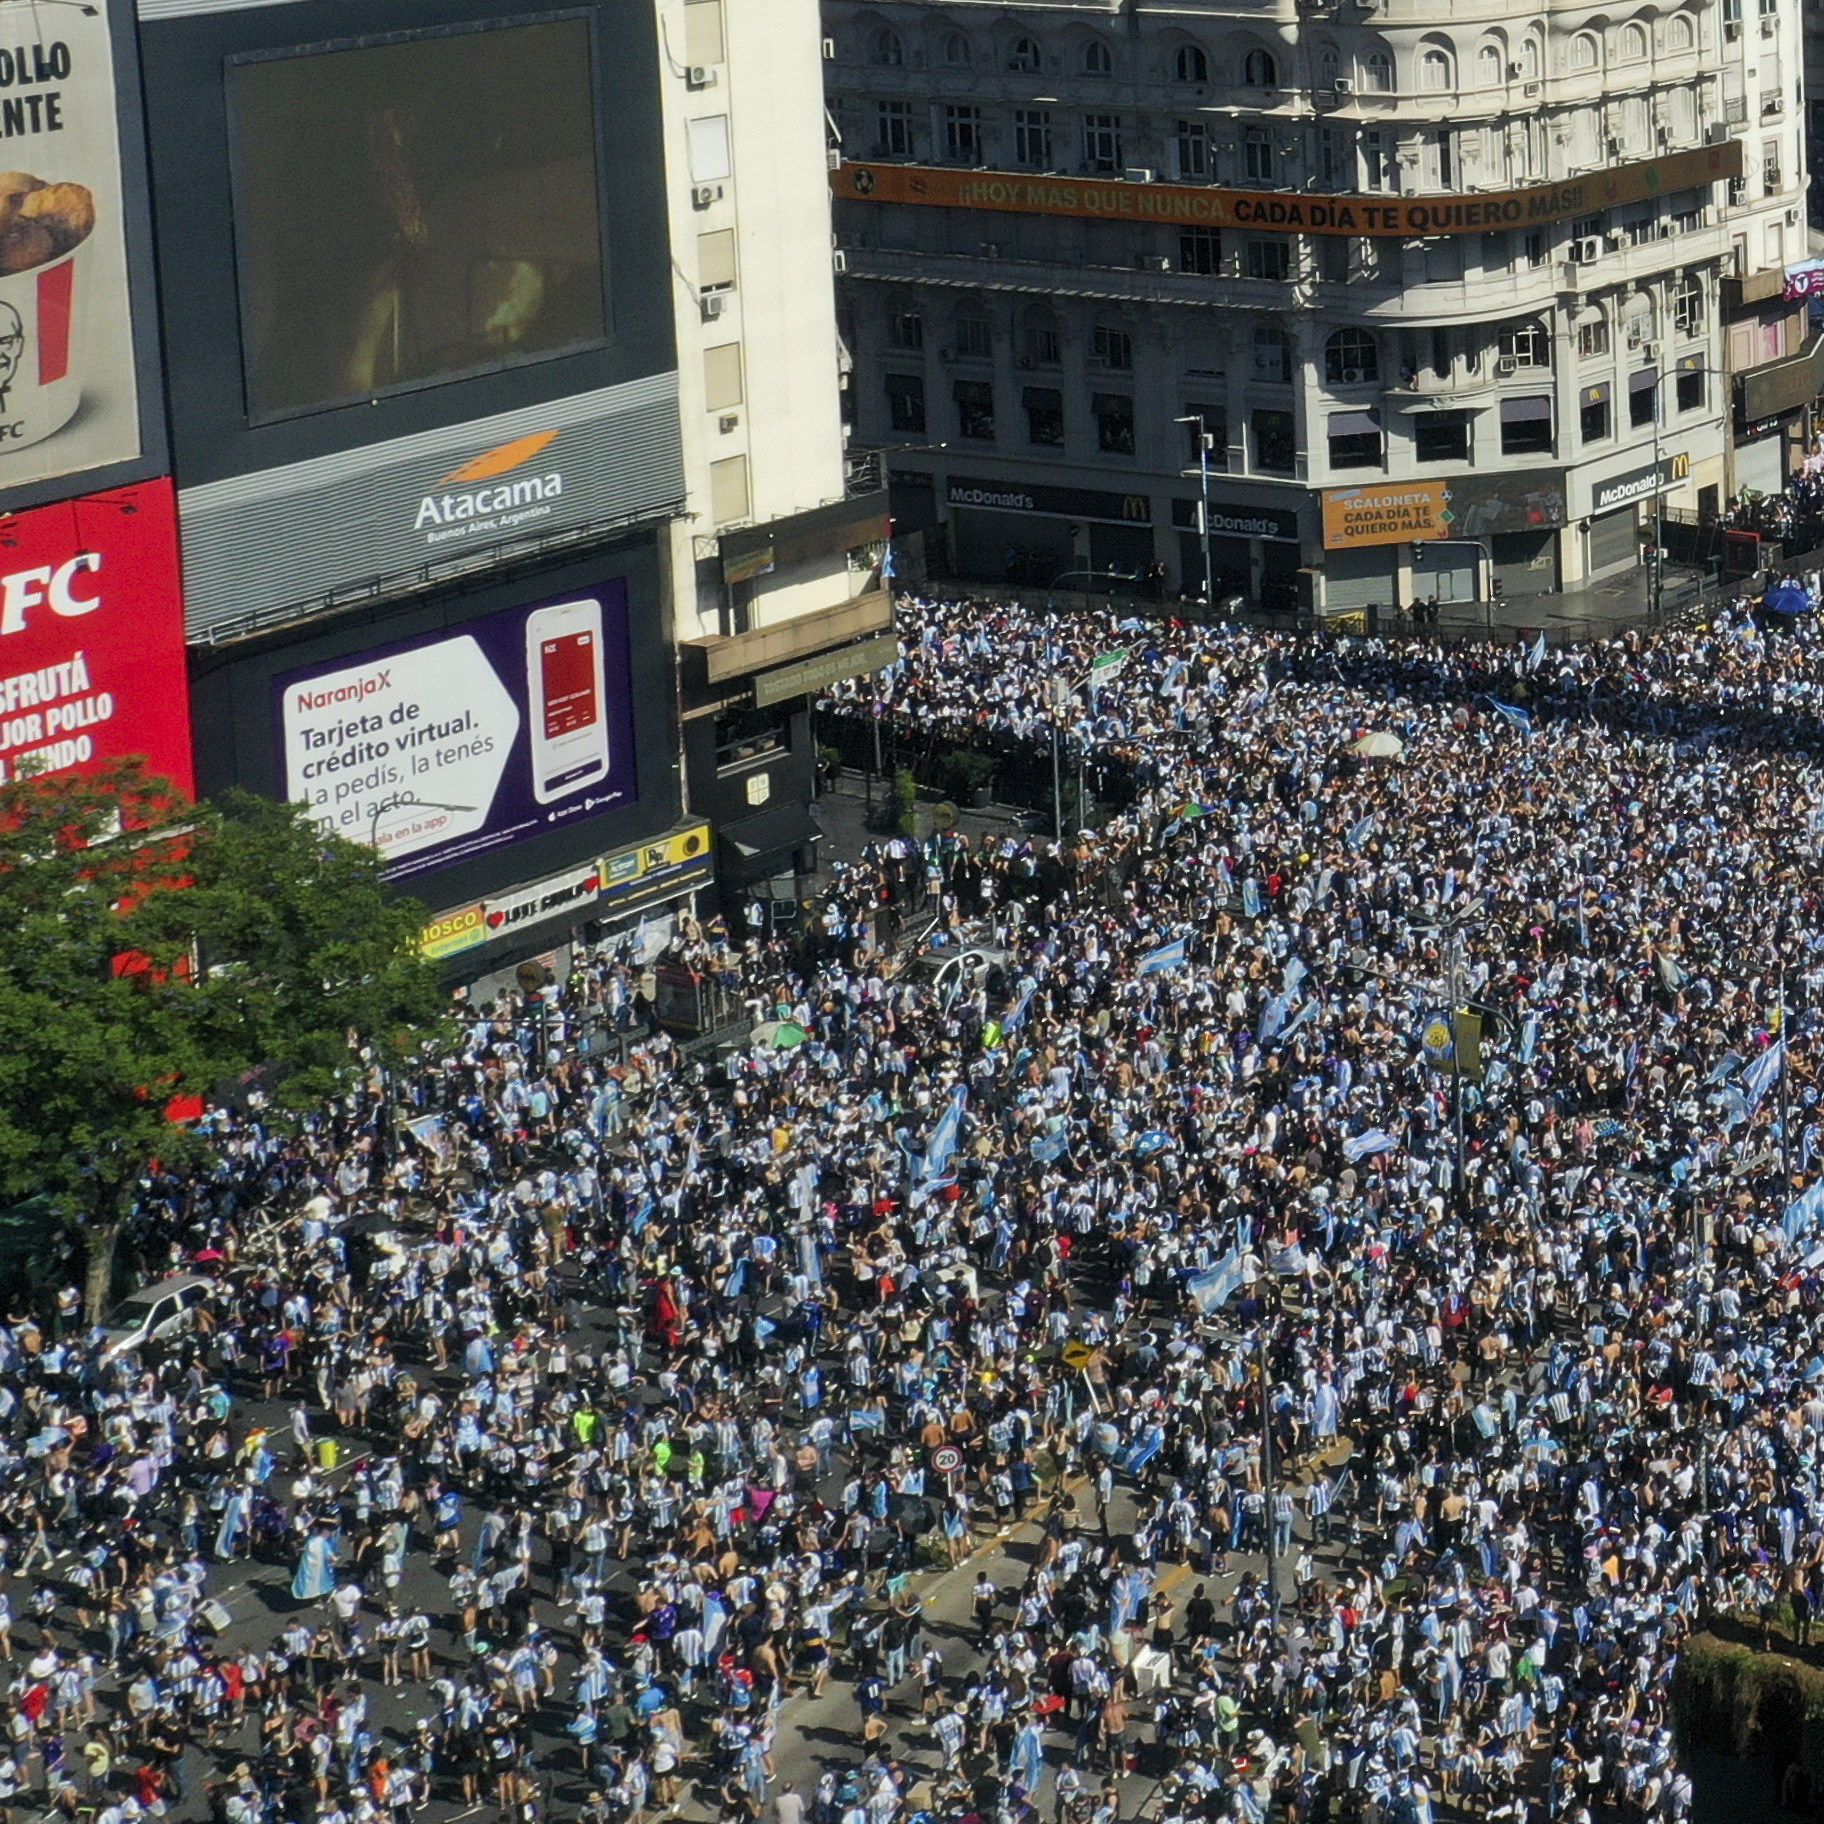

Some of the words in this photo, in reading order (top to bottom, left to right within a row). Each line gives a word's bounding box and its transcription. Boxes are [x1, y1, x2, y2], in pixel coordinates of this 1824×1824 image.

[0, 91, 64, 139] NTE
[1083, 190, 1132, 215] QUE
[1136, 192, 1232, 222] NUNCA,
[1233, 199, 1304, 225] CADA
[1309, 198, 1353, 229] DÍA
[1361, 206, 1401, 229] TE
[1407, 197, 1523, 232] QUIERO
[413, 472, 562, 530] Atacama
[950, 486, 1035, 509] McDonald's
[1343, 492, 1432, 511] SCALONETA
[1343, 510, 1384, 524] CADA
[1385, 507, 1411, 521] DÍA
[1413, 505, 1431, 518] TE
[427, 526, 466, 544] Buenos
[499, 504, 551, 526] Argentina
[1343, 520, 1398, 538] QUIERO
[0, 552, 101, 636] FC
[46, 691, 114, 737] POLLO
[300, 713, 384, 752] Tarjeta
[389, 701, 420, 725] de
[301, 740, 390, 780] crédito
[395, 708, 480, 752] virtual.
[335, 763, 406, 805] pedís,
[411, 755, 430, 776] la
[435, 734, 495, 768] tenés
[340, 801, 361, 827] el
[365, 789, 422, 820] acto.
[394, 824, 410, 840] en
[411, 819, 423, 834] la
[423, 814, 449, 833] app
[938, 1453, 956, 1466] 20
